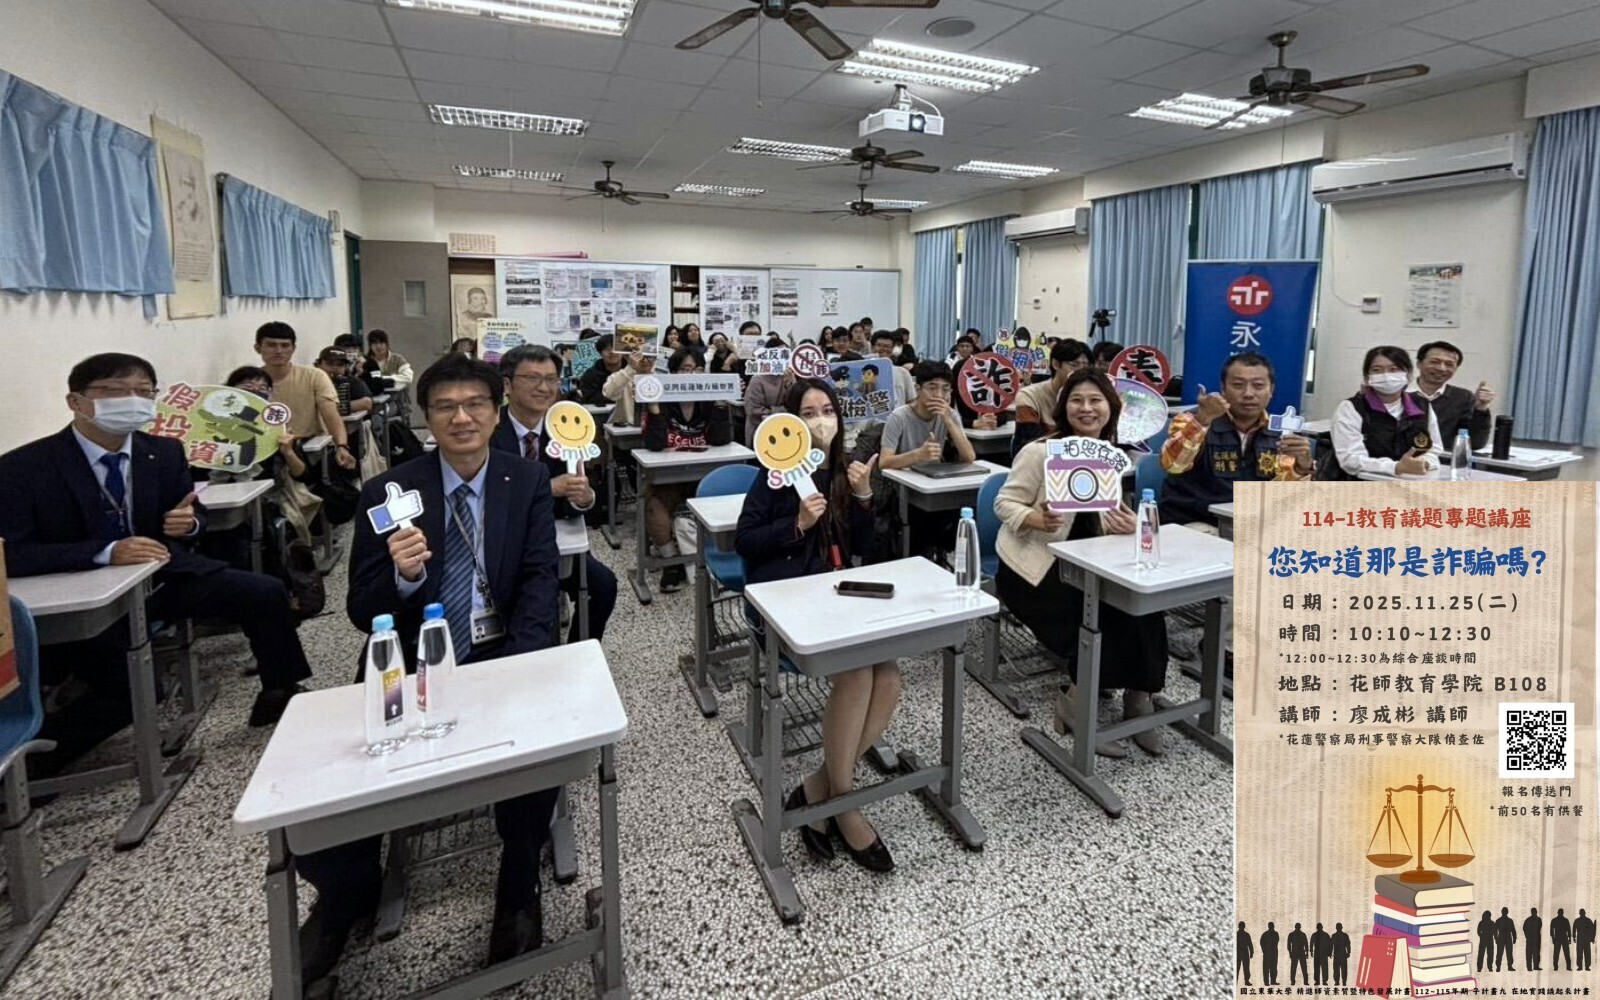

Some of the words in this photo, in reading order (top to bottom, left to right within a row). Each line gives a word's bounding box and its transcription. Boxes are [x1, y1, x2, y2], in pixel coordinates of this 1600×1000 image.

[1230, 320, 1262, 348] 永
[964, 357, 1014, 408] 詐
[548, 441, 600, 461] Smile
[768, 449, 825, 487] Smile
